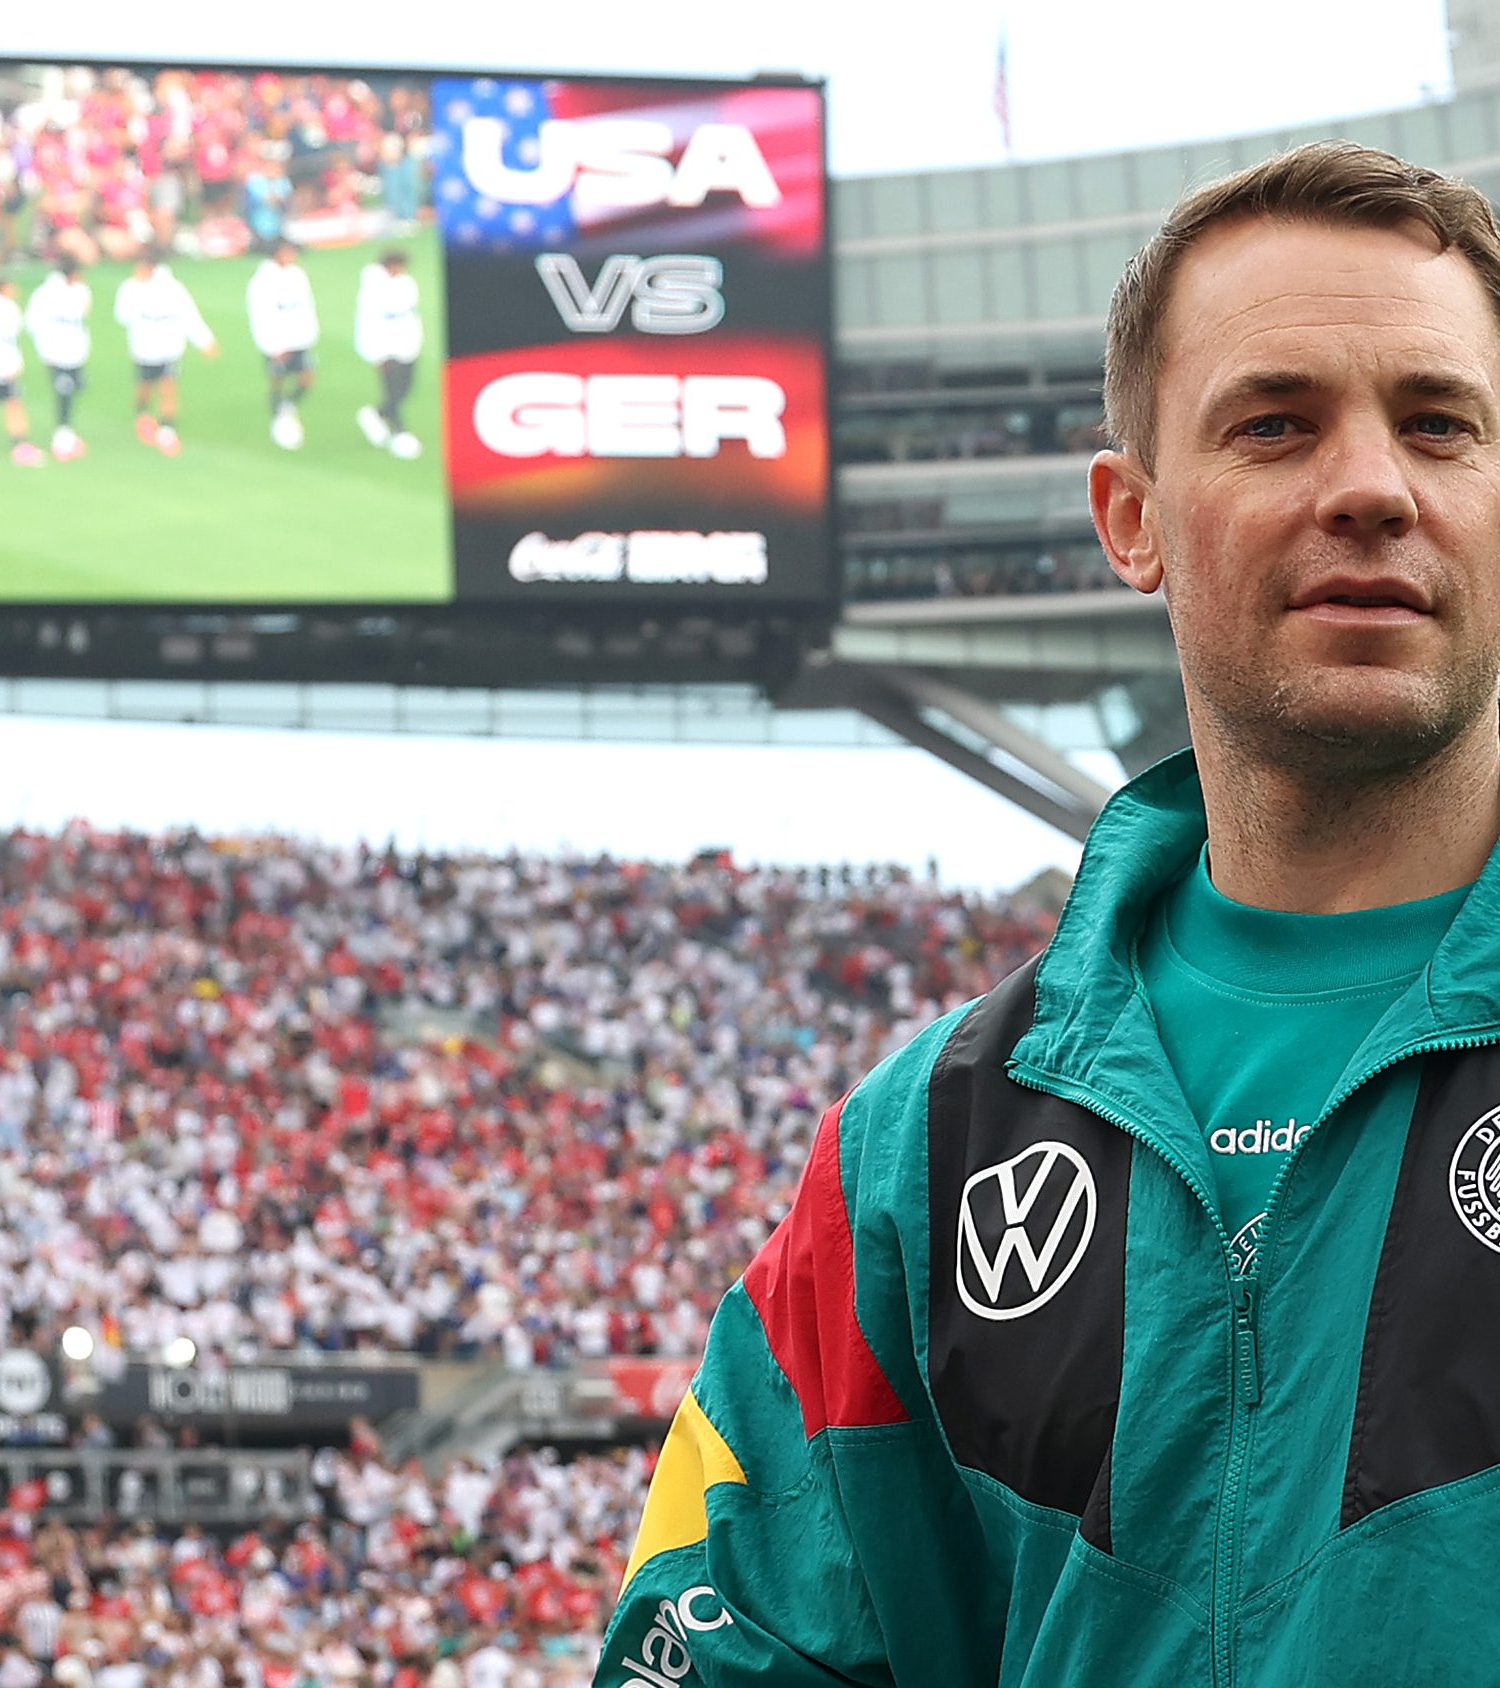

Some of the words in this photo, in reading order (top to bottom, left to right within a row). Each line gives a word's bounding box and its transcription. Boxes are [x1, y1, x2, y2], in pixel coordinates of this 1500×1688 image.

[462, 117, 781, 207] USA
[535, 253, 726, 333] VS
[473, 371, 787, 459] GER
